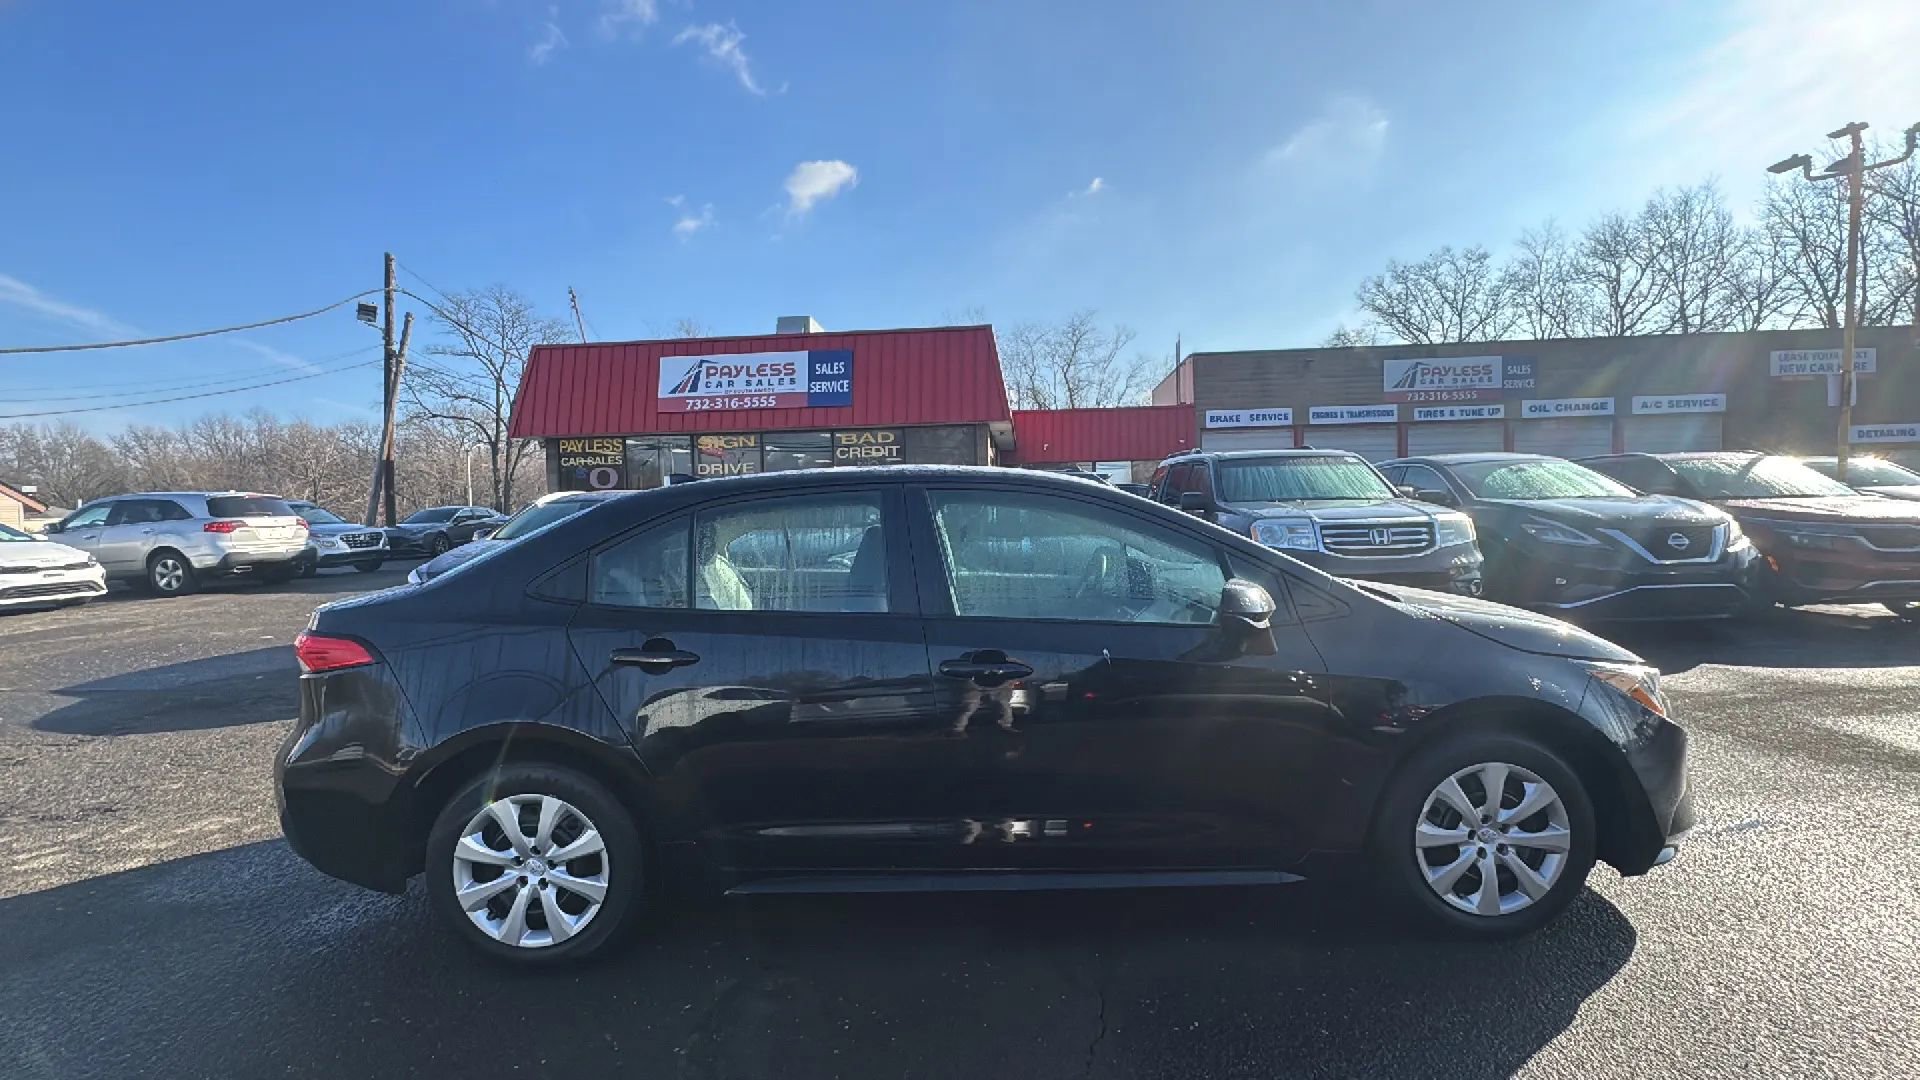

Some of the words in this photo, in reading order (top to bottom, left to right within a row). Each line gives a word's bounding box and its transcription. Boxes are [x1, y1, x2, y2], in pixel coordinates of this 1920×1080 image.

[1778, 352, 1808, 362] LEASE
[706, 362, 796, 379] PAYLESS
[815, 362, 845, 375] SALES
[1420, 364, 1493, 378] PAYLESS
[1507, 365, 1531, 375] SALES
[1779, 364, 1807, 373] NEW
[1810, 363, 1834, 373] CAR
[705, 380, 735, 389] CAR
[745, 378, 796, 387] SALES
[810, 380, 849, 393] SERVICE
[1504, 378, 1535, 389] SERVICE
[1407, 390, 1477, 401] 732-316-5555
[686, 395, 776, 411] 732-316-5555
[1528, 403, 1550, 413] OIL
[1555, 401, 1609, 412] CHANGE
[1640, 401, 1663, 409] A/C
[1667, 398, 1719, 409] SERVICE
[1209, 414, 1241, 423] BRAKE
[1249, 413, 1289, 422] SERVICE
[1311, 411, 1338, 420] ENGINES
[1346, 409, 1395, 419] TRANSMISSIONS
[1417, 409, 1445, 418] TIRES
[1460, 408, 1484, 417] TUNE
[1487, 407, 1501, 416] UP
[841, 432, 895, 445] BAD
[1857, 428, 1917, 439] DETAILING
[559, 439, 623, 453] PAYLESS
[697, 435, 756, 449] SIGN
[836, 445, 901, 459] CREDIT
[560, 457, 584, 467] CAR
[586, 455, 622, 466] SALES
[697, 462, 755, 475] DRIVE
